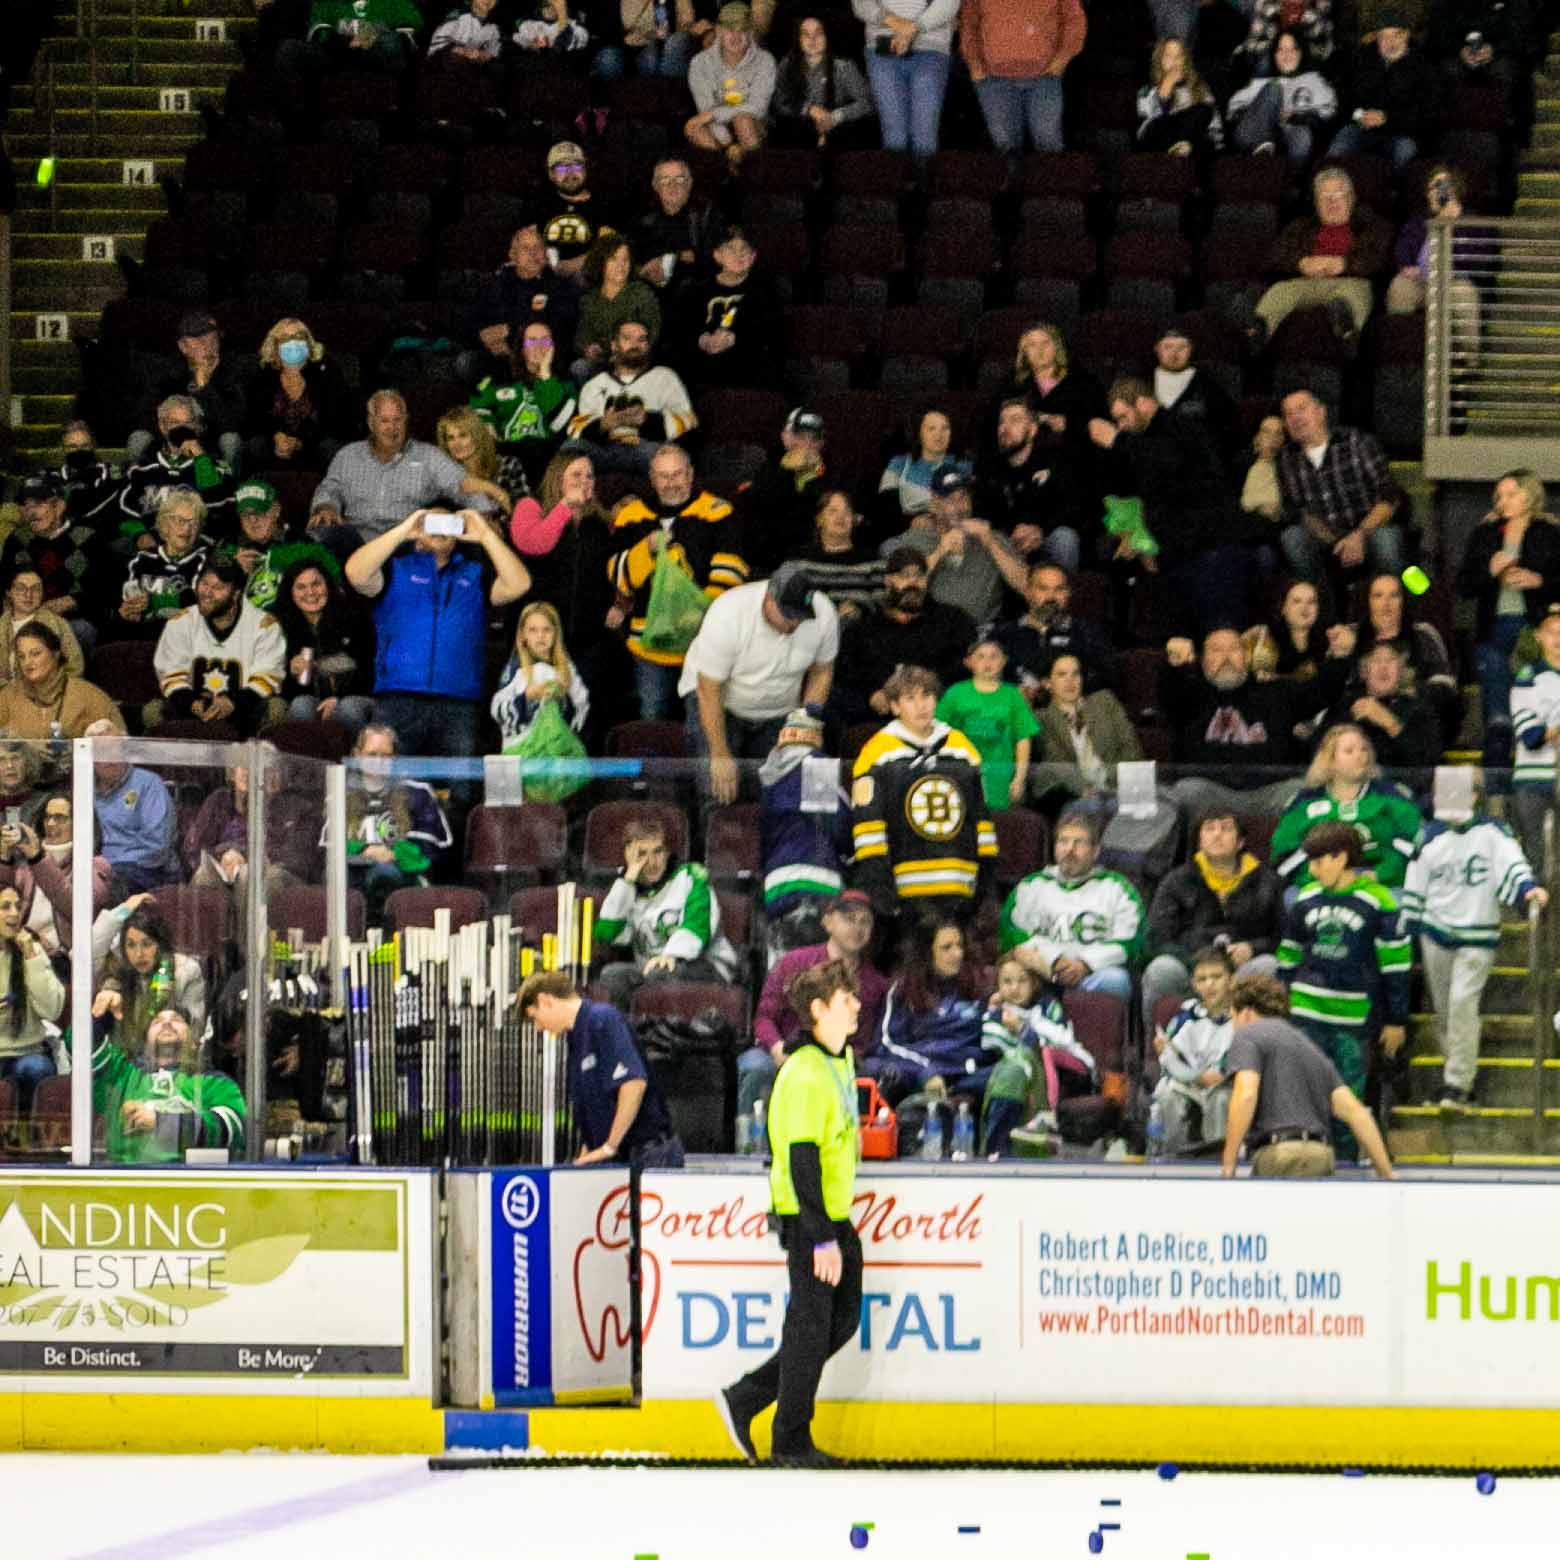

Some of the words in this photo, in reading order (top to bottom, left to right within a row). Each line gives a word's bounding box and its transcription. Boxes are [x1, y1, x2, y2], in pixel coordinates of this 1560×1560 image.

[164, 94, 185, 111] 15
[129, 167, 145, 185] 14
[42, 320, 61, 338] 12
[597, 1184, 767, 1249] Portla
[851, 1190, 984, 1244] North
[1040, 1232, 1109, 1262] Robert
[1116, 1233, 1129, 1262] A
[1137, 1233, 1215, 1266] DeRice,
[1222, 1234, 1269, 1263] DMD
[0, 1254, 58, 1289] AL
[74, 1256, 227, 1291] ESTATE
[1039, 1269, 1164, 1304] Christopher
[1170, 1270, 1183, 1298] D
[1191, 1270, 1289, 1302] Pochebit,
[1296, 1272, 1342, 1299] DMD
[512, 1232, 530, 1390] WARRIOR
[676, 1290, 981, 1352] DETAL
[1039, 1305, 1366, 1338] www.PortlandNorthDental.com
[44, 1346, 65, 1366] Be
[71, 1346, 141, 1368] Distinct.
[238, 1348, 260, 1369] Be
